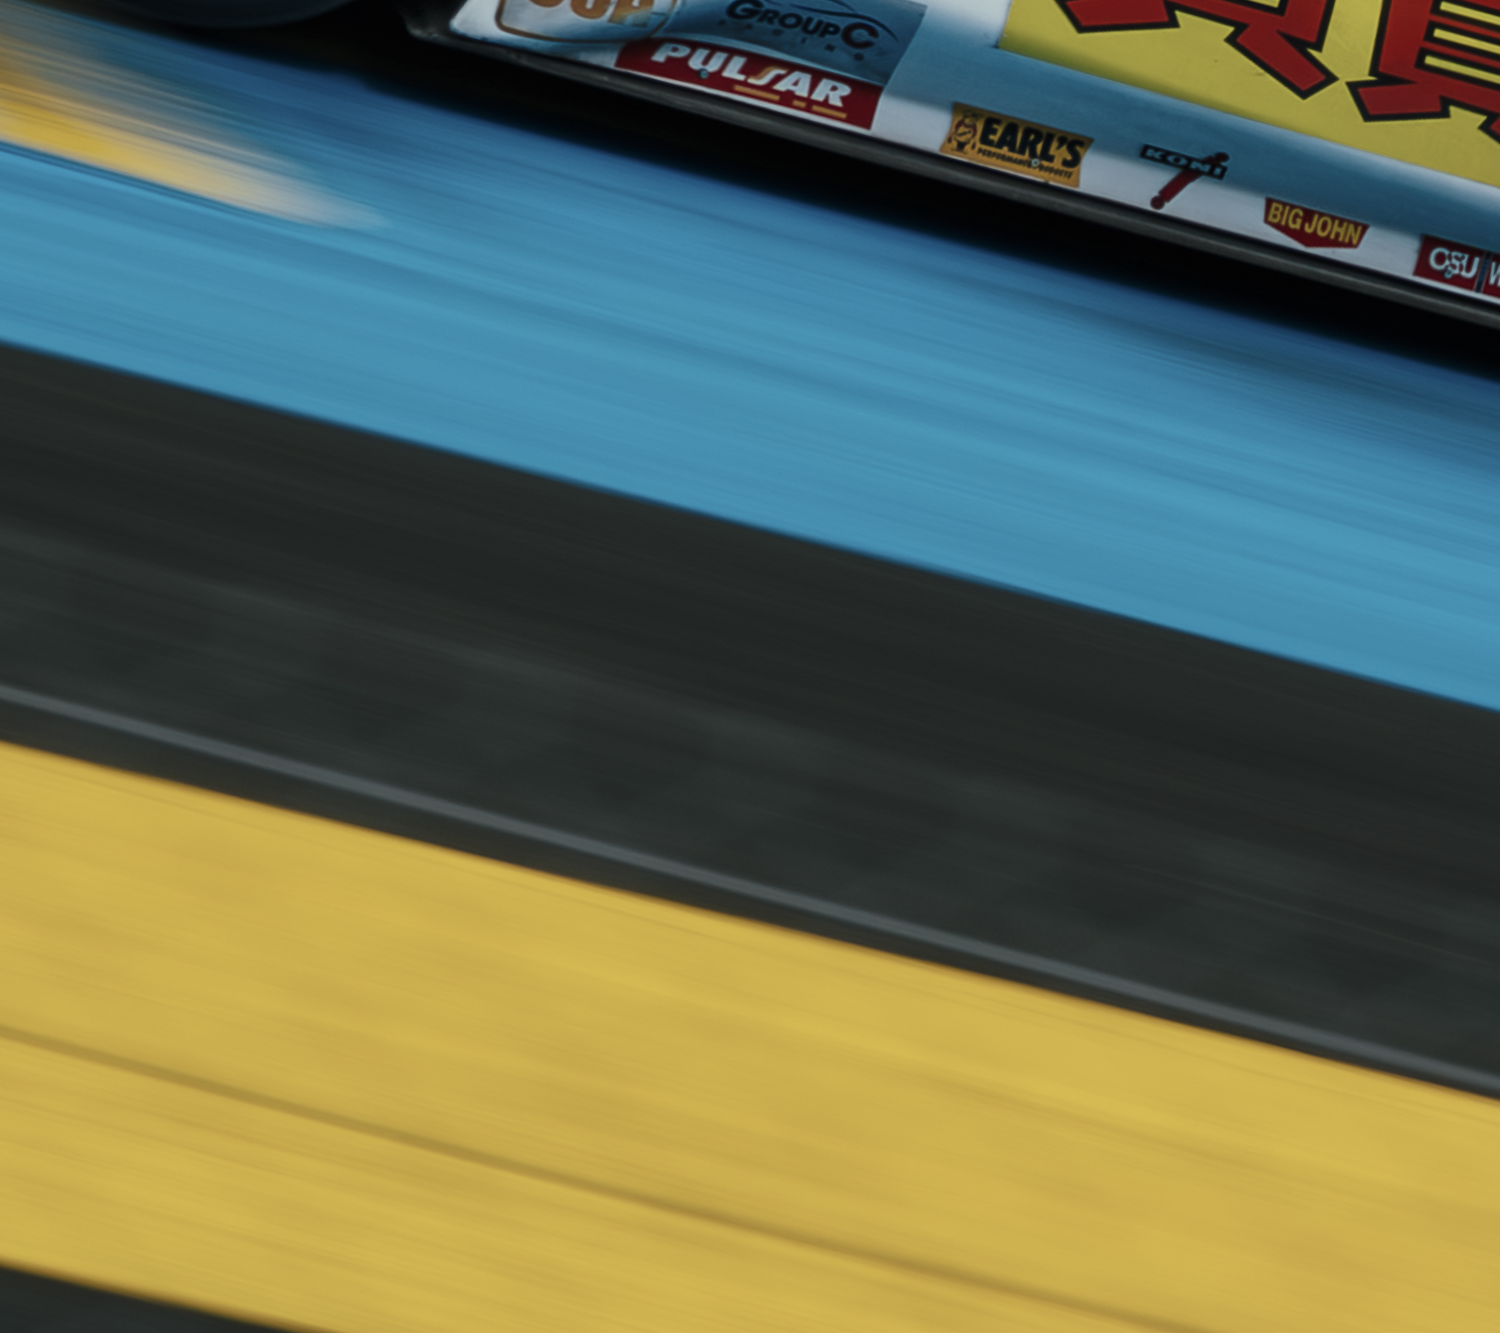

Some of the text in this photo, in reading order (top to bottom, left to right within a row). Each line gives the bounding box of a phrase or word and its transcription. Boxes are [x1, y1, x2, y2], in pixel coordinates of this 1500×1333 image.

[651, 43, 851, 107] PULSAR
[1266, 202, 1362, 246] BIG JOHN
